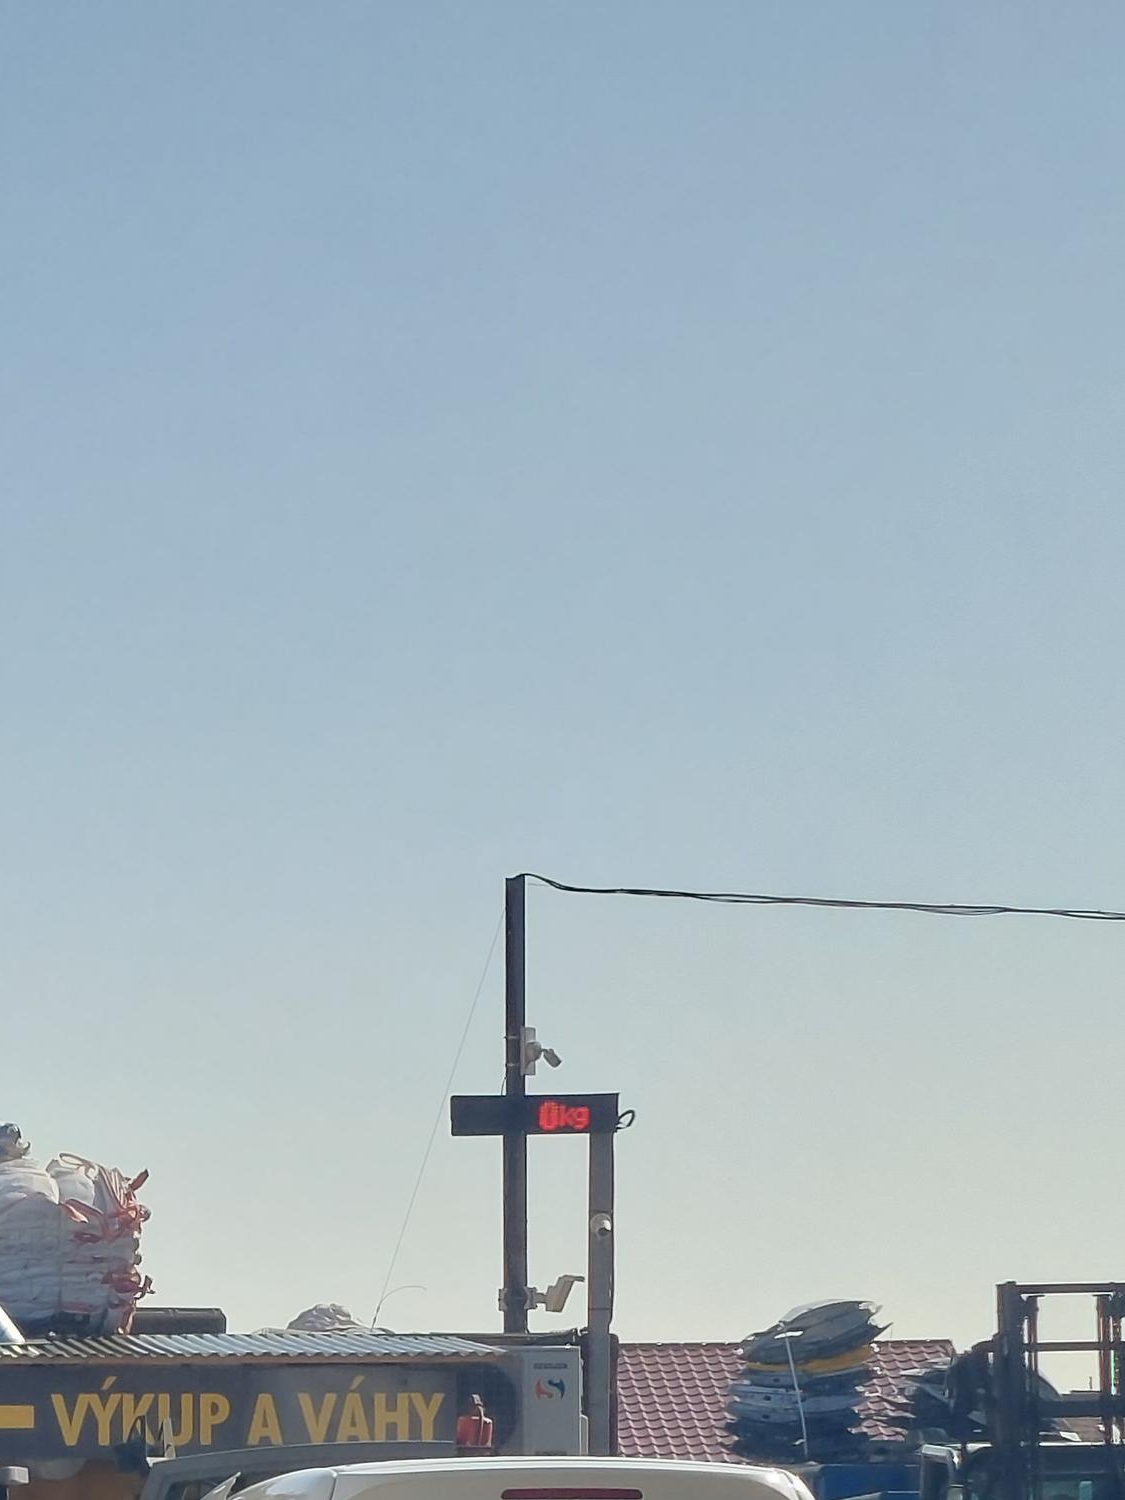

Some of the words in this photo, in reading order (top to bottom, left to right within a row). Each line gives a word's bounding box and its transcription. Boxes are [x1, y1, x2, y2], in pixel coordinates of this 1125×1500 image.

[50, 1376, 231, 1447] VÝKUP
[247, 1393, 284, 1446] A
[297, 1376, 446, 1444] VÁHY
